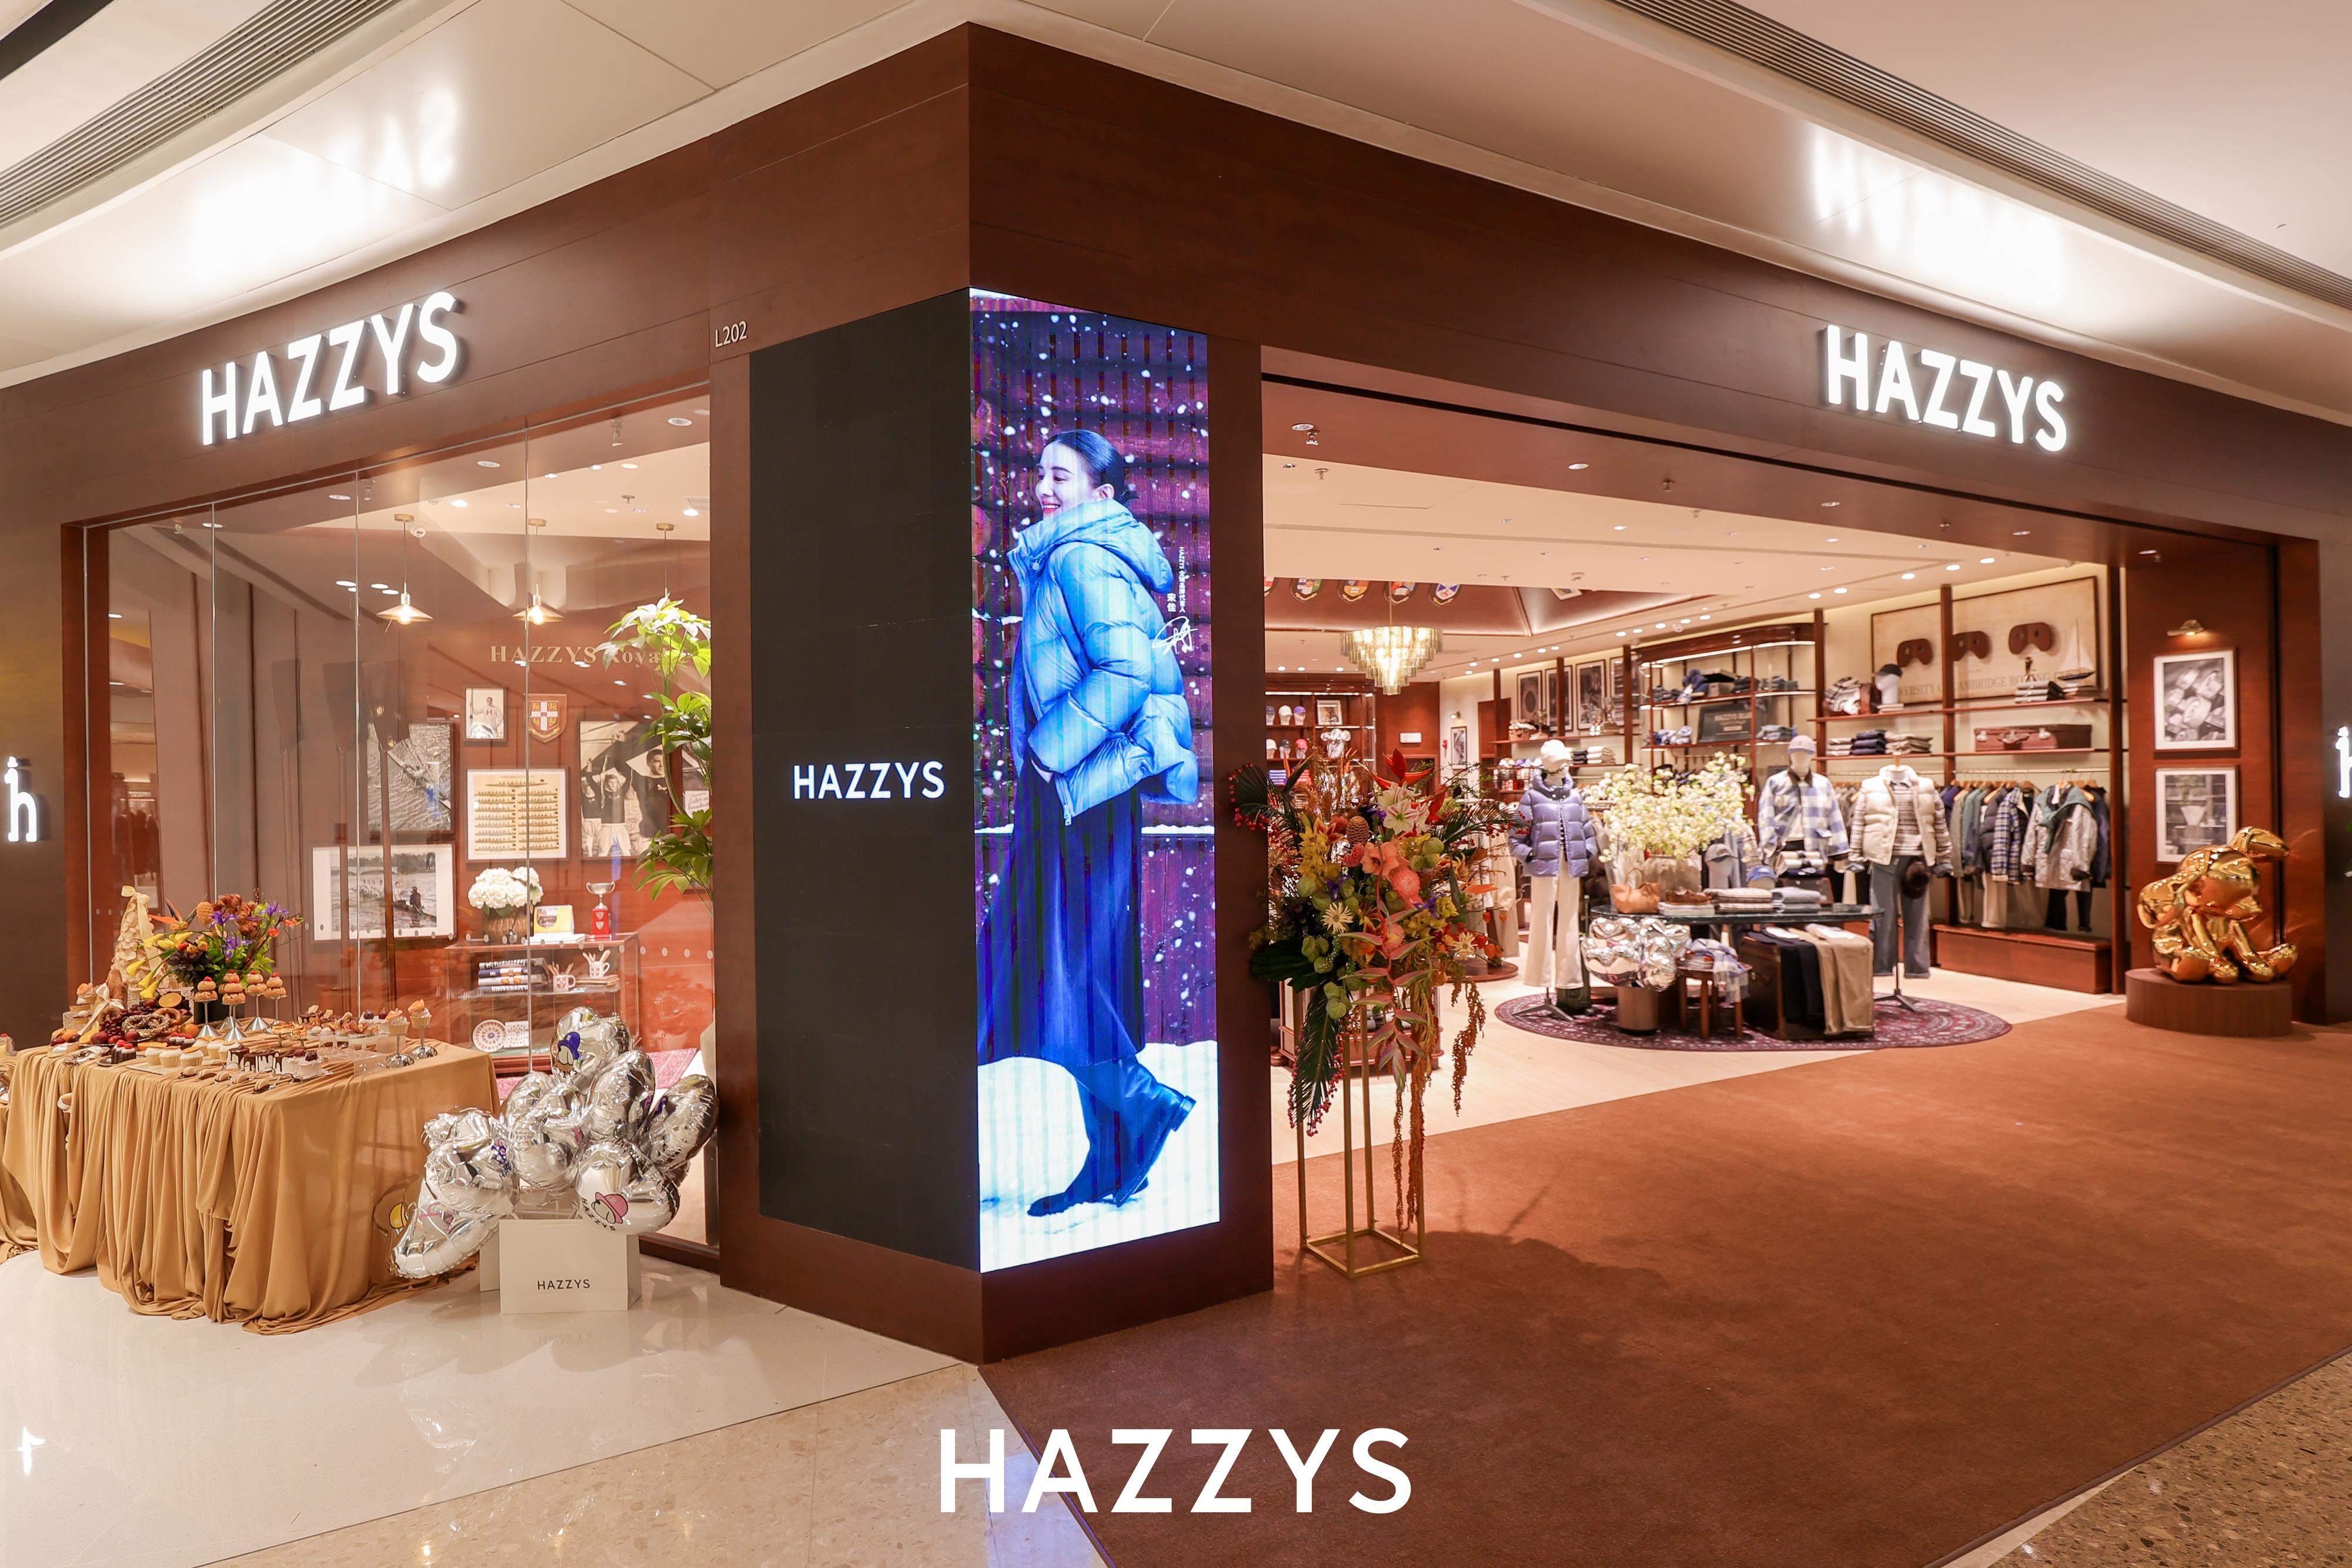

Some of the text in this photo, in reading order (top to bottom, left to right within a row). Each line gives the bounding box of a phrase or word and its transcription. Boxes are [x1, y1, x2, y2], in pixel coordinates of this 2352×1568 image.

[716, 321, 747, 347] L202
[202, 292, 457, 446] HAZZYS
[1828, 325, 2067, 452] HAZZYS
[1167, 593, 1176, 612] 宋佳
[490, 646, 596, 663] HAZZYS
[793, 761, 944, 799] HAZZYS
[537, 1279, 590, 1290] HAZZYS
